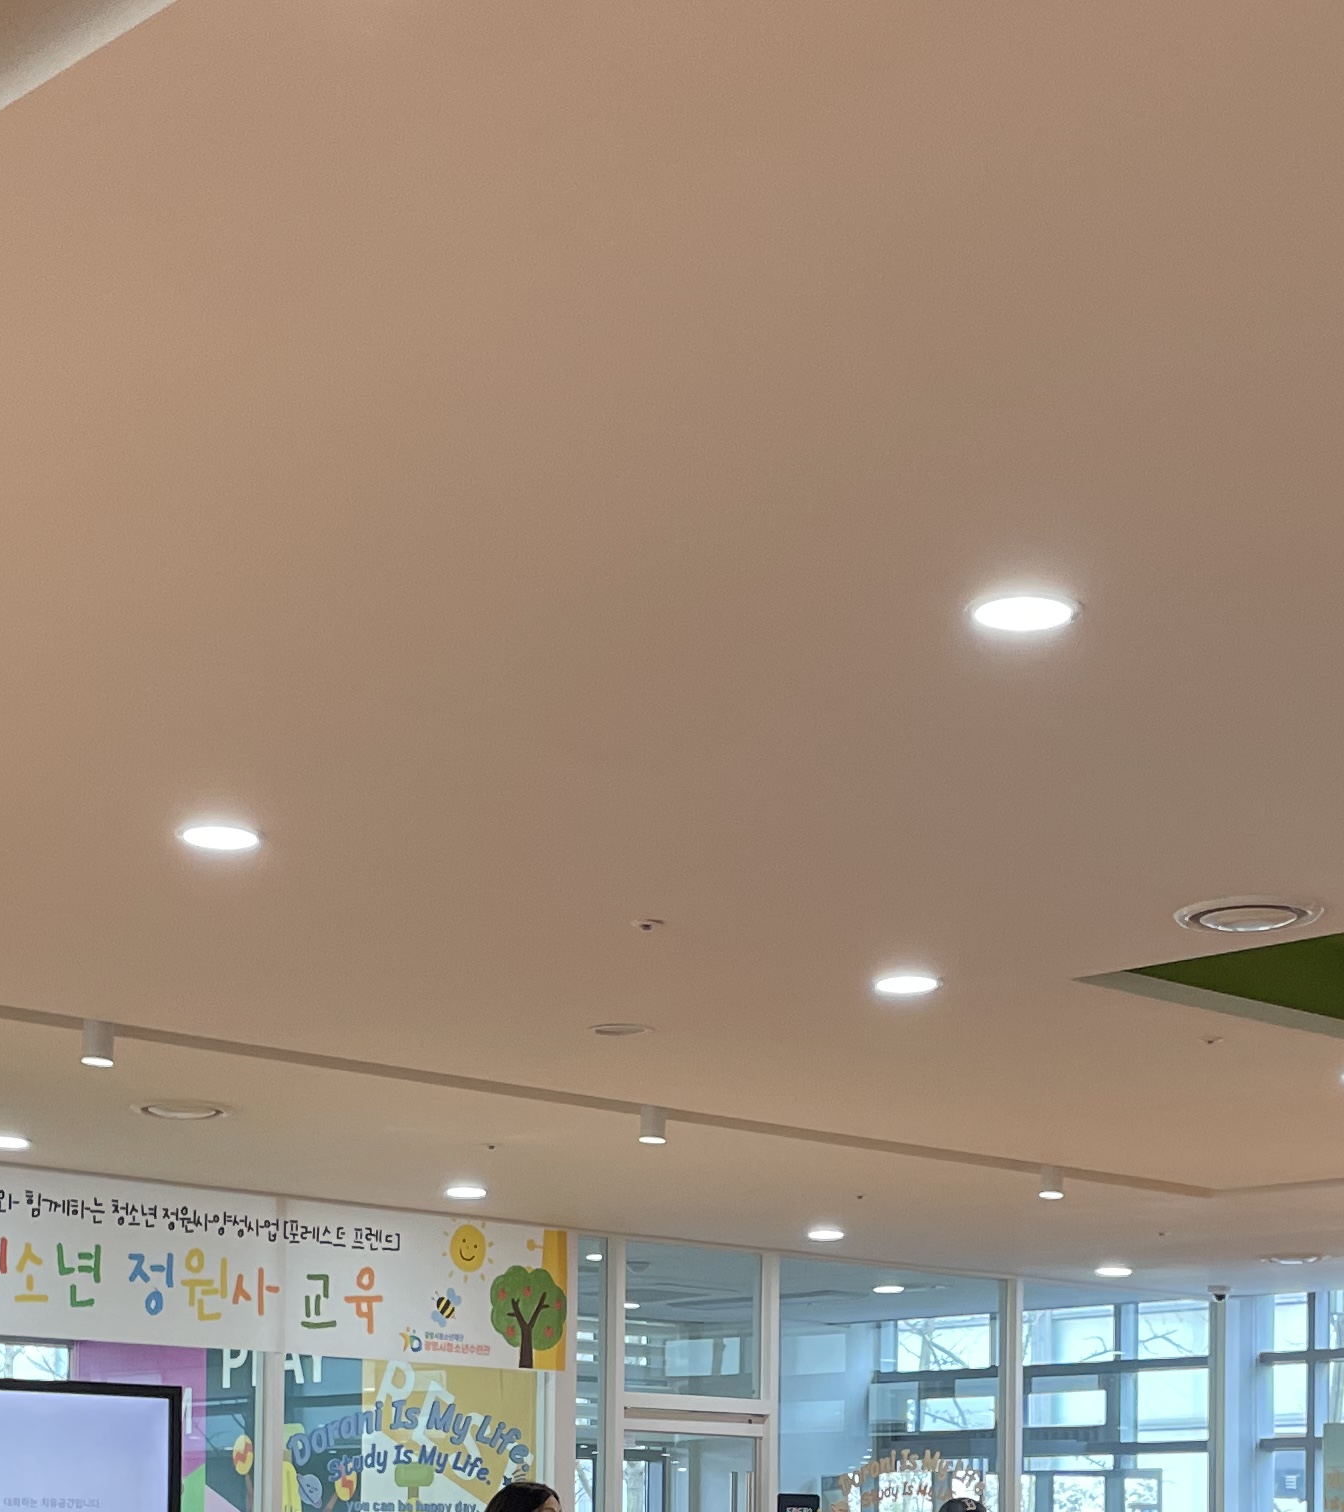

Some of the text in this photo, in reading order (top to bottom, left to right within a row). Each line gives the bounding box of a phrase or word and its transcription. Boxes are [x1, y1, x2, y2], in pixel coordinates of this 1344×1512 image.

[24, 1190, 105, 1224] 함께하는
[352, 1226, 401, 1251] 프렌드]
[128, 1248, 280, 1322] 정원사
[301, 1266, 384, 1335] 교육
[287, 1400, 384, 1466] Dorani
[390, 1399, 421, 1430] Is
[427, 1400, 472, 1445] My
[327, 1444, 492, 1485] Study Is My Life.
[373, 1502, 395, 1512] can
[398, 1500, 413, 1512] be
